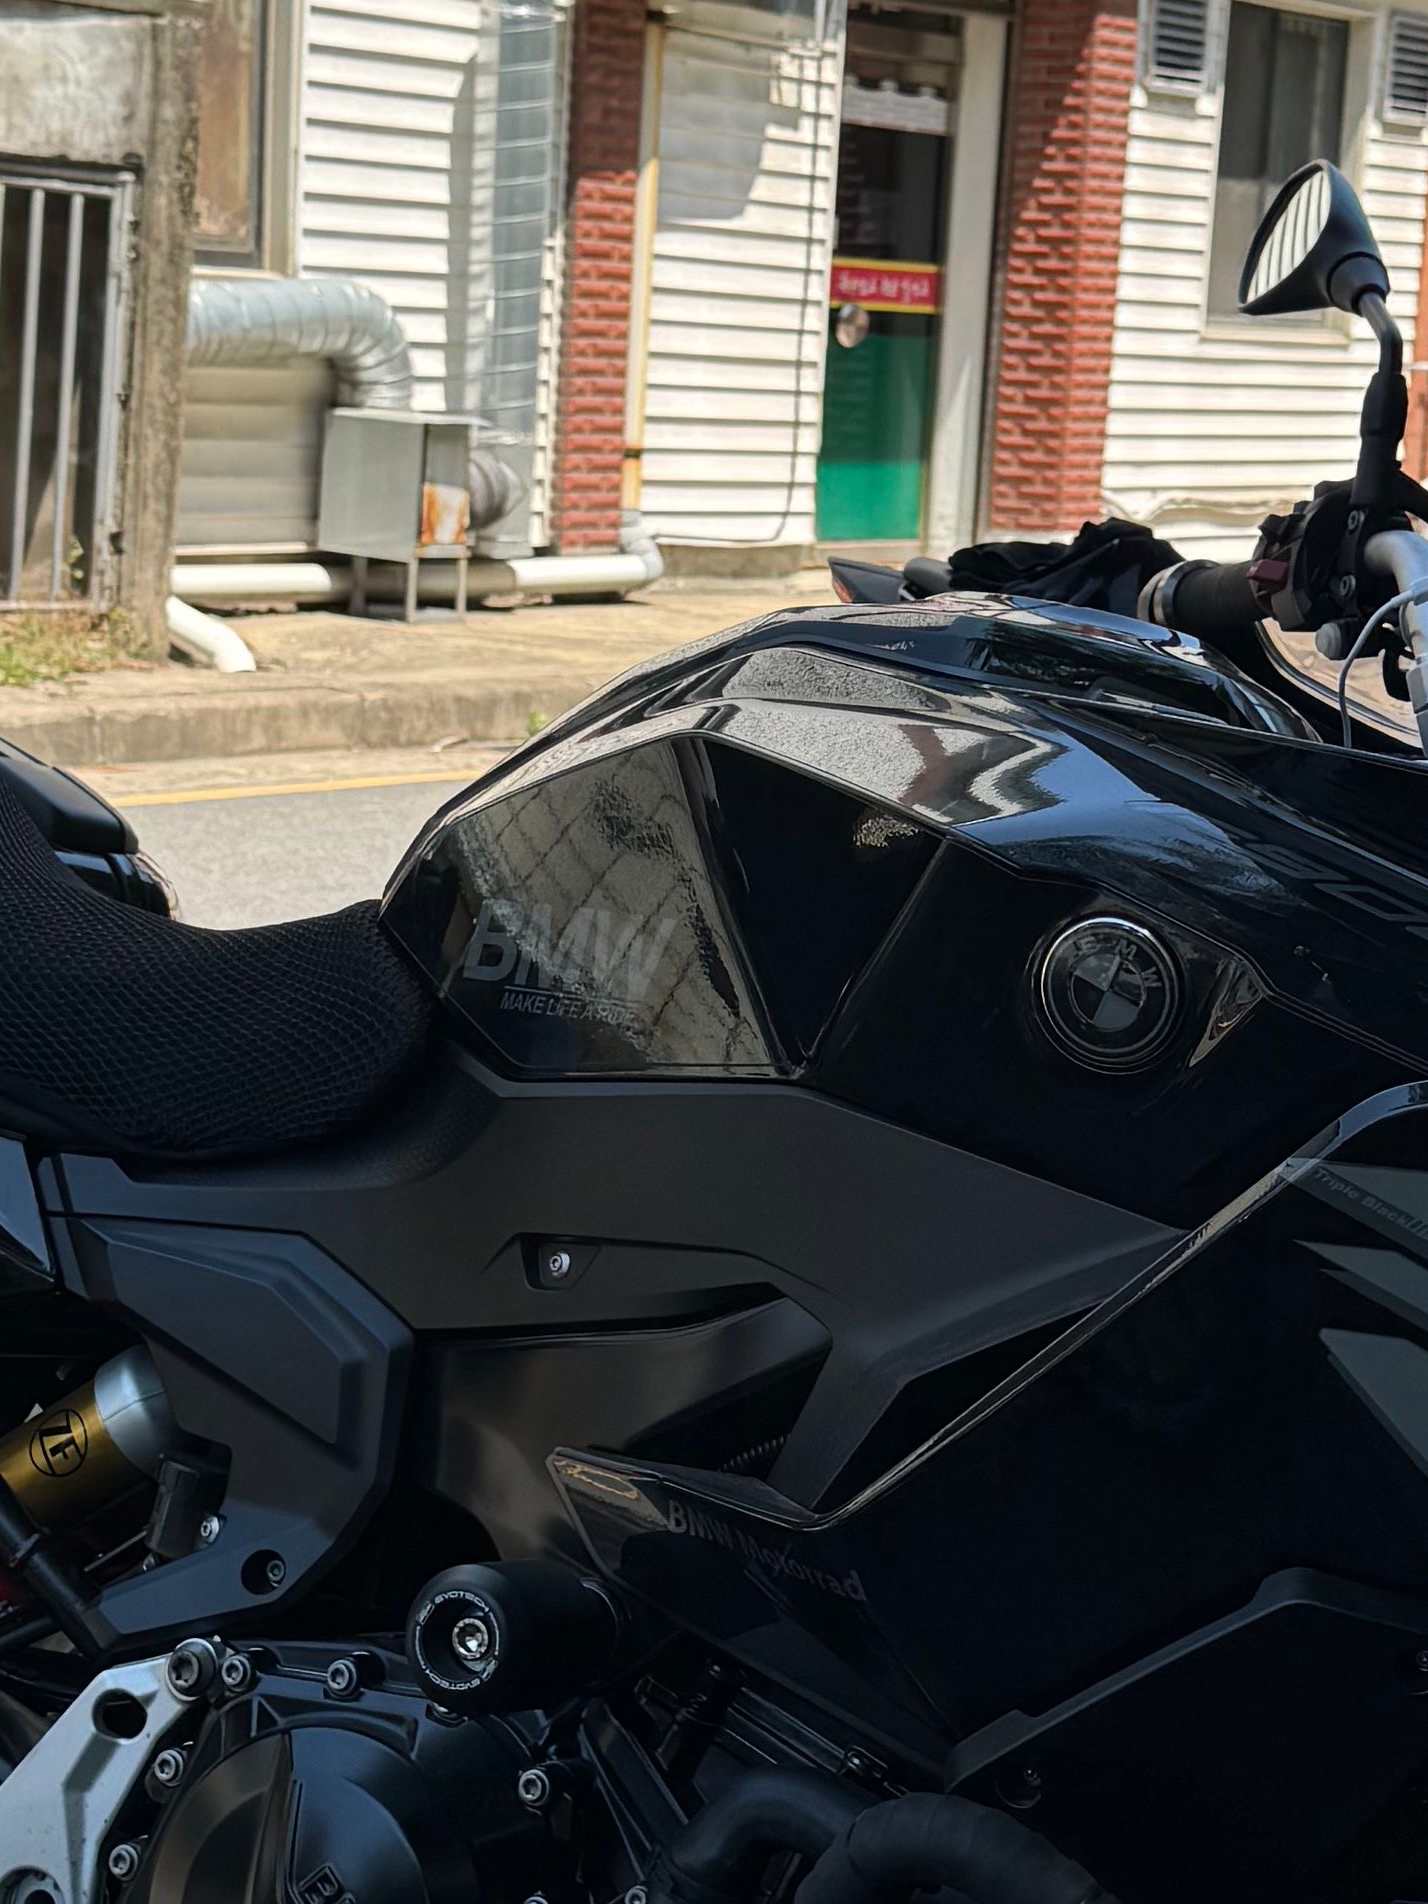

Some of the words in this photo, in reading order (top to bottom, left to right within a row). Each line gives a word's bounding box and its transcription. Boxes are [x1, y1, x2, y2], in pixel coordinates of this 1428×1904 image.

[462, 898, 677, 999] BMW
[500, 992, 543, 1014] MAKE
[546, 998, 578, 1019] LIFE
[668, 1498, 735, 1551] BMW
